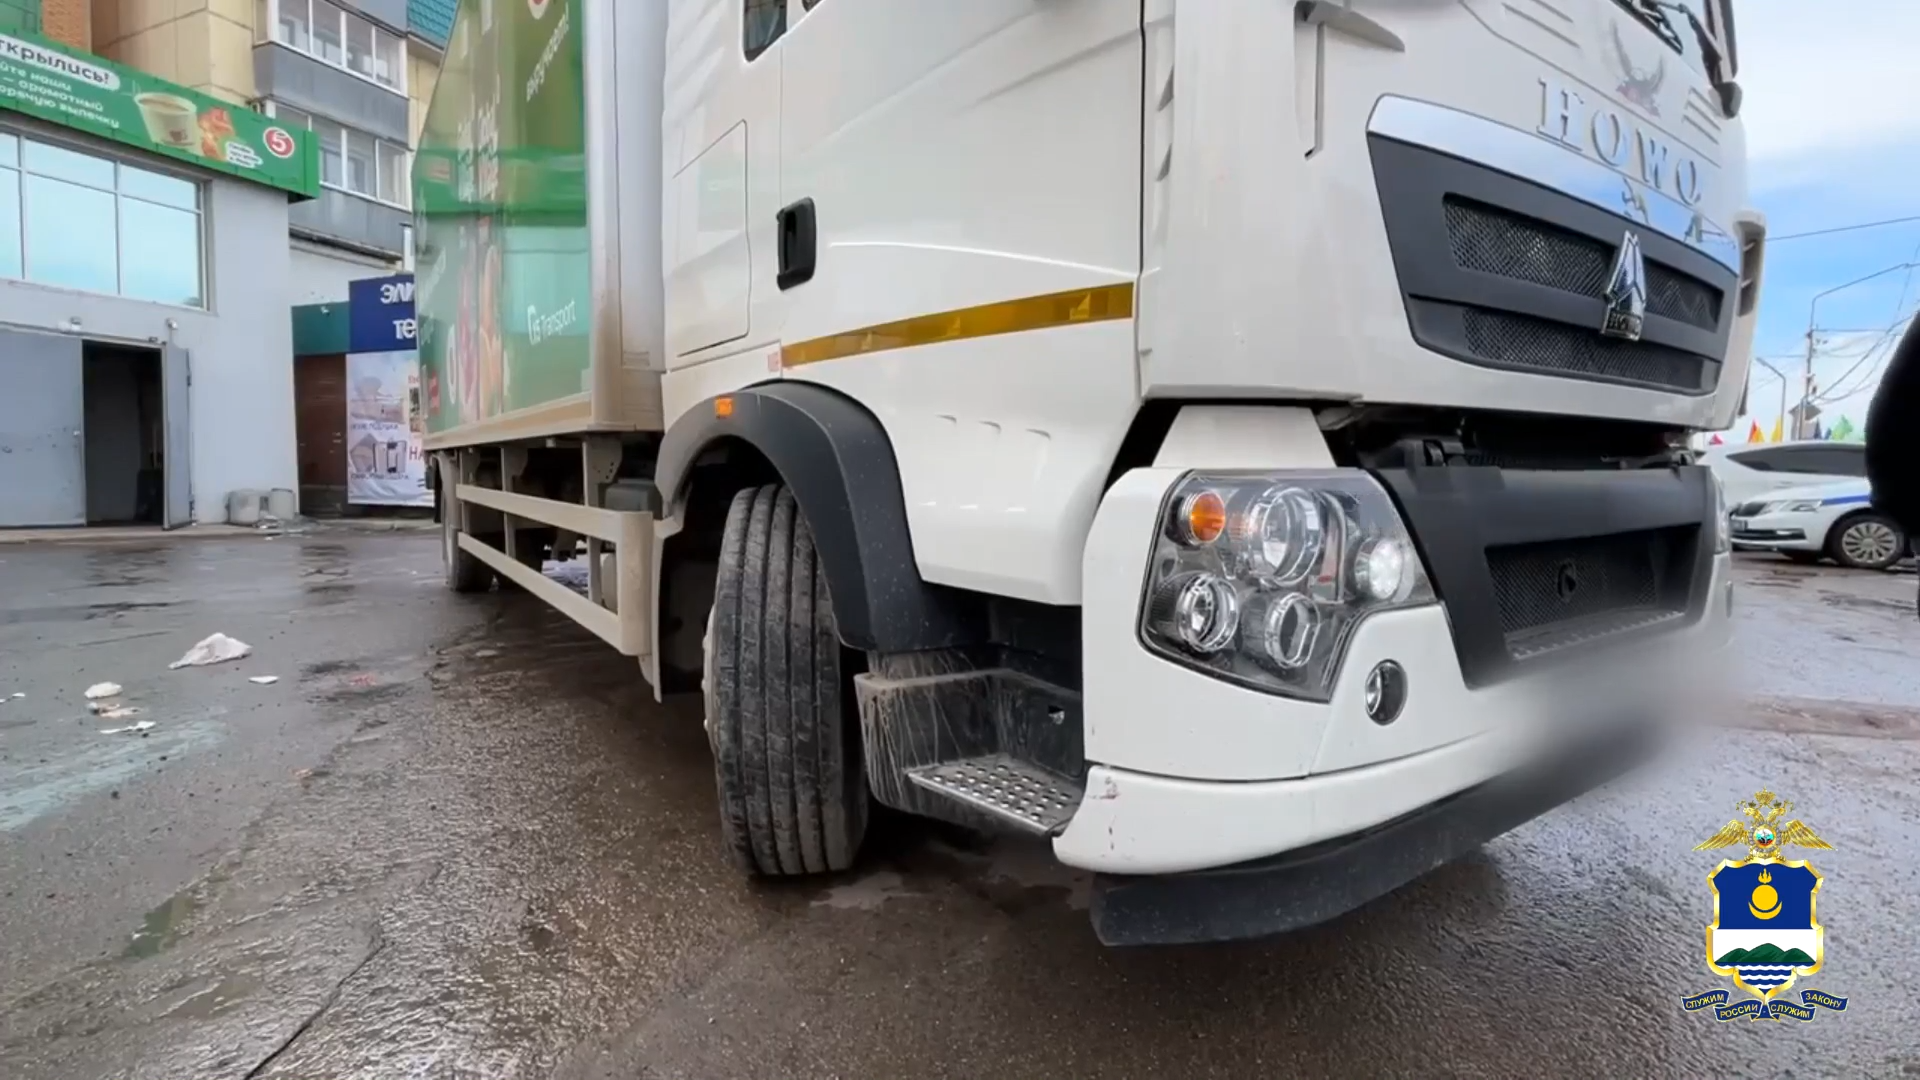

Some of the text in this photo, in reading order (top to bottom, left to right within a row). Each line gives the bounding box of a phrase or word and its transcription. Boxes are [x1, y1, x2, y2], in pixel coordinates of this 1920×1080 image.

[18, 79, 104, 112] ароматный
[30, 72, 72, 92] наши
[59, 102, 119, 129] выпечку
[1537, 75, 1701, 207] HOWO
